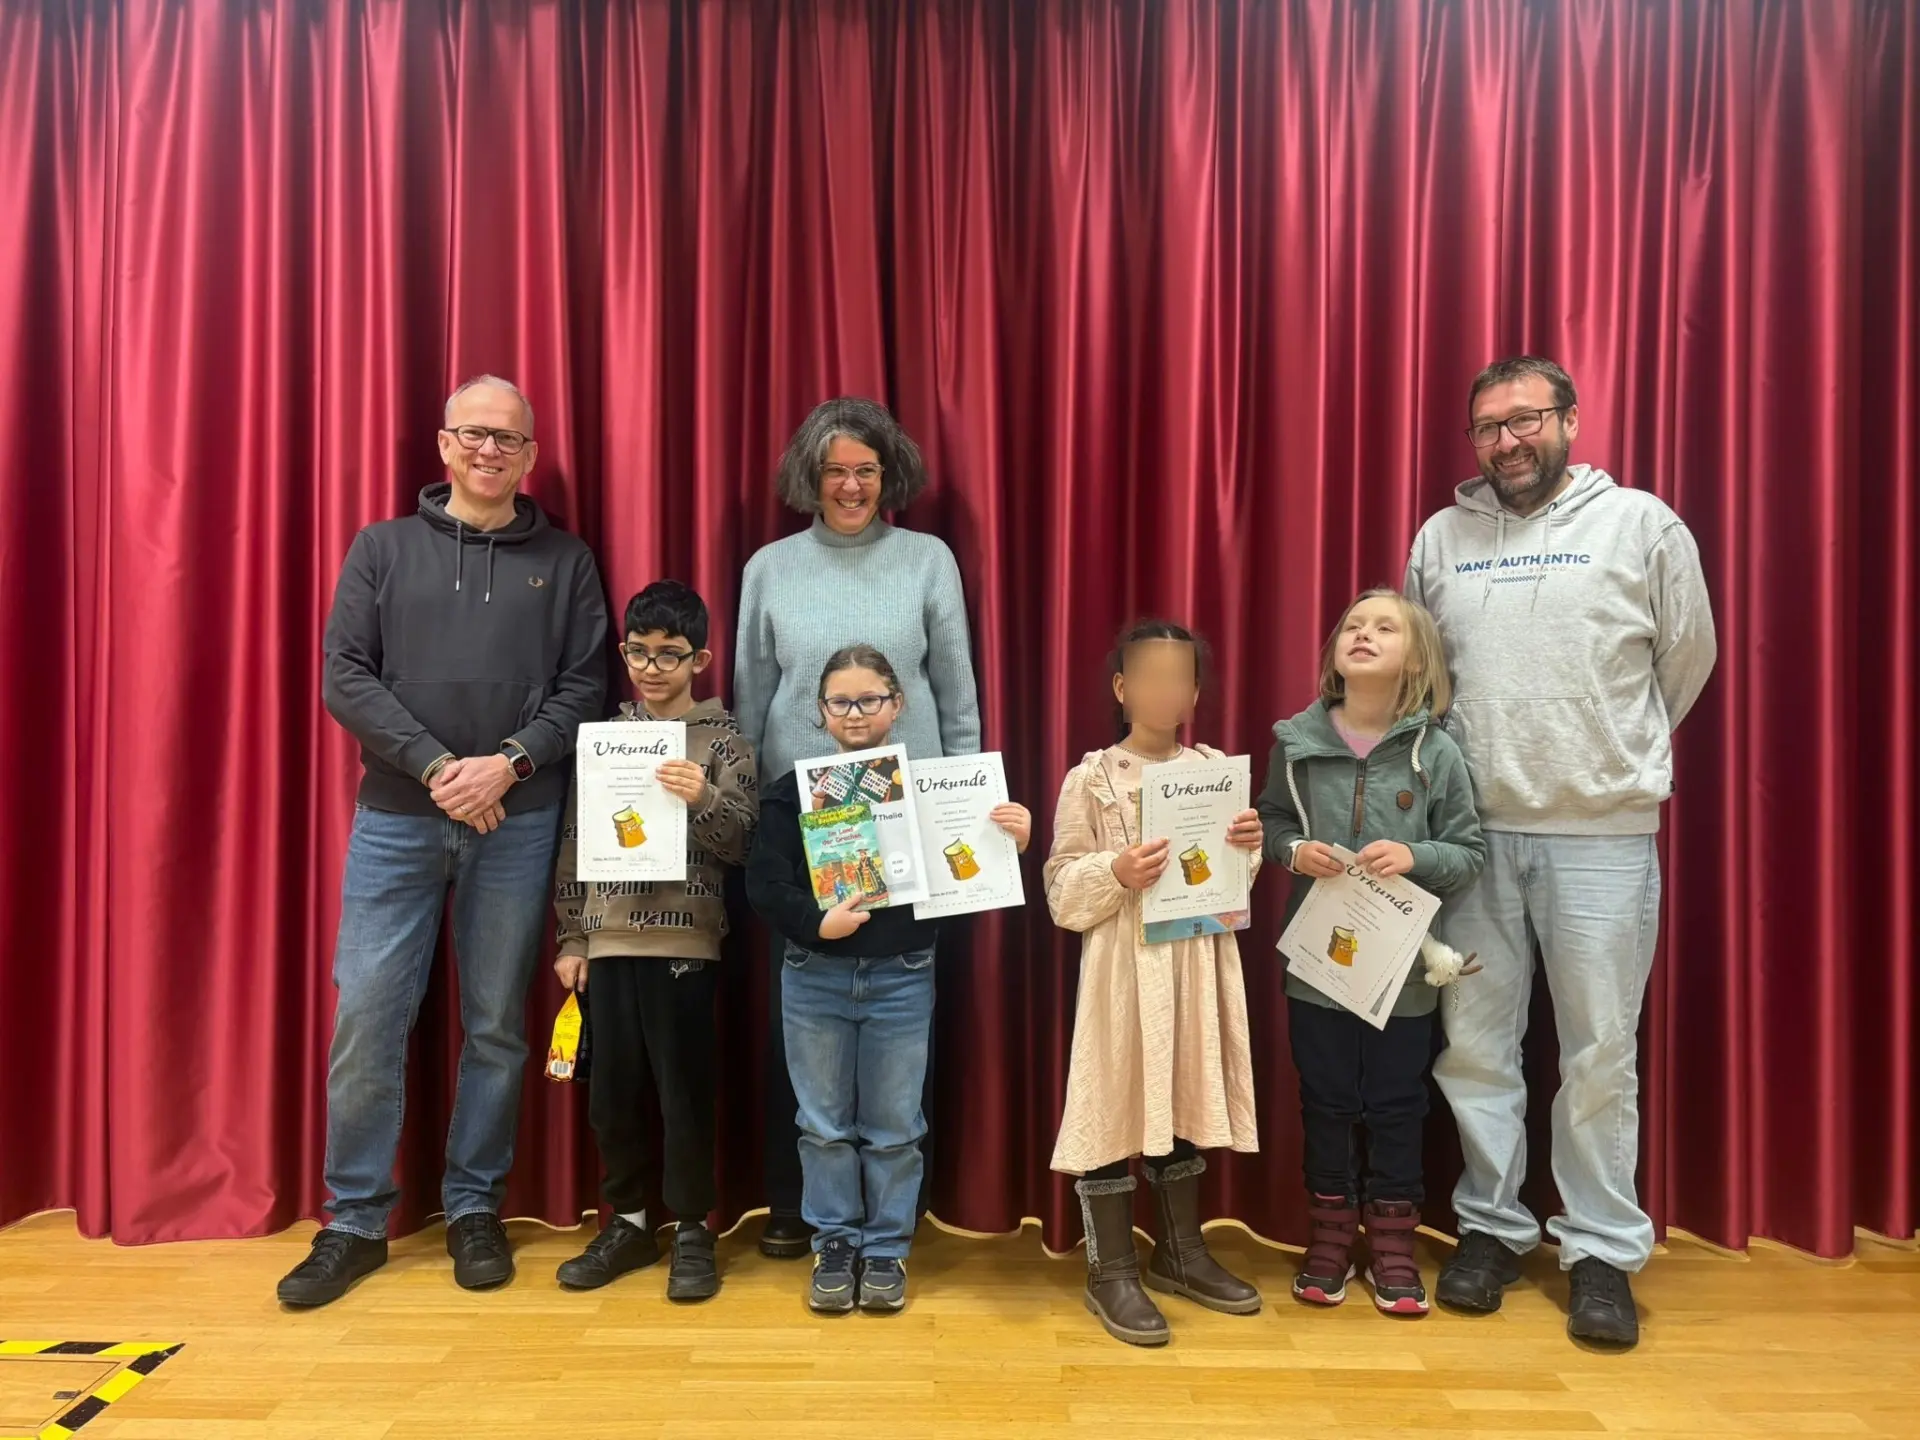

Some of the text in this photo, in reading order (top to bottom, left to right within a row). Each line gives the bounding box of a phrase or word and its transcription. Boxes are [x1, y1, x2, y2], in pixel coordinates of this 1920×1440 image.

[1455, 553, 1591, 574] VANS AUTHENTIC
[593, 738, 668, 756] Urkunde
[916, 769, 987, 793] Urkunde
[1161, 775, 1233, 799] Urkunde
[879, 812, 903, 822] Thalia
[1346, 863, 1413, 916] Urkunde
[628, 910, 694, 929] PUMA
